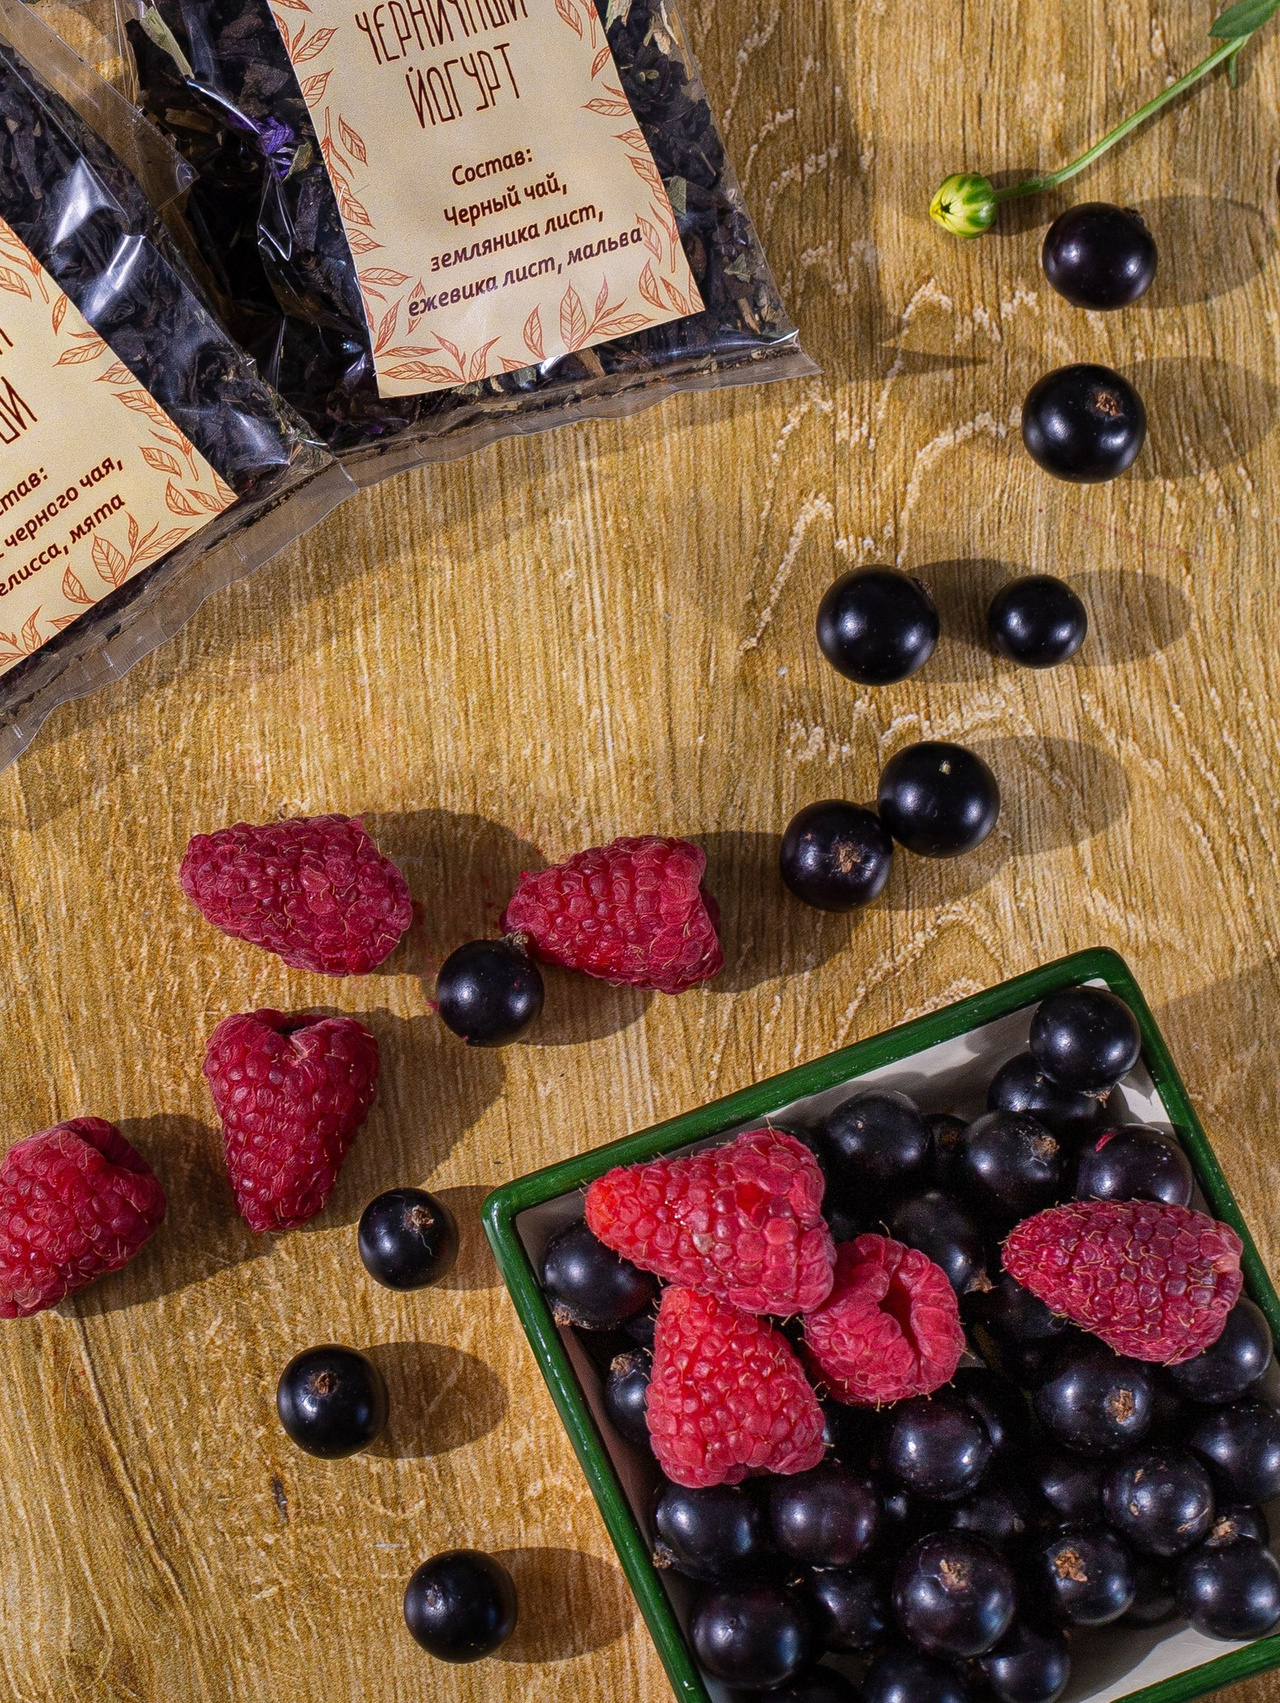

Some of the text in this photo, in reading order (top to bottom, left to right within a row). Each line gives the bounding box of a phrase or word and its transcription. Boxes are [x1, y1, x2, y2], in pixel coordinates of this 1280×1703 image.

[405, 43, 520, 129] ЙОГУРТ
[443, 172, 568, 227] Черный чай,
[451, 148, 533, 186] Состав:
[408, 227, 643, 317] ежевика лист, мальва
[430, 204, 604, 272] земляника лист,
[4, 486, 79, 548] черного
[79, 457, 124, 489] чая,
[69, 494, 126, 544] мята
